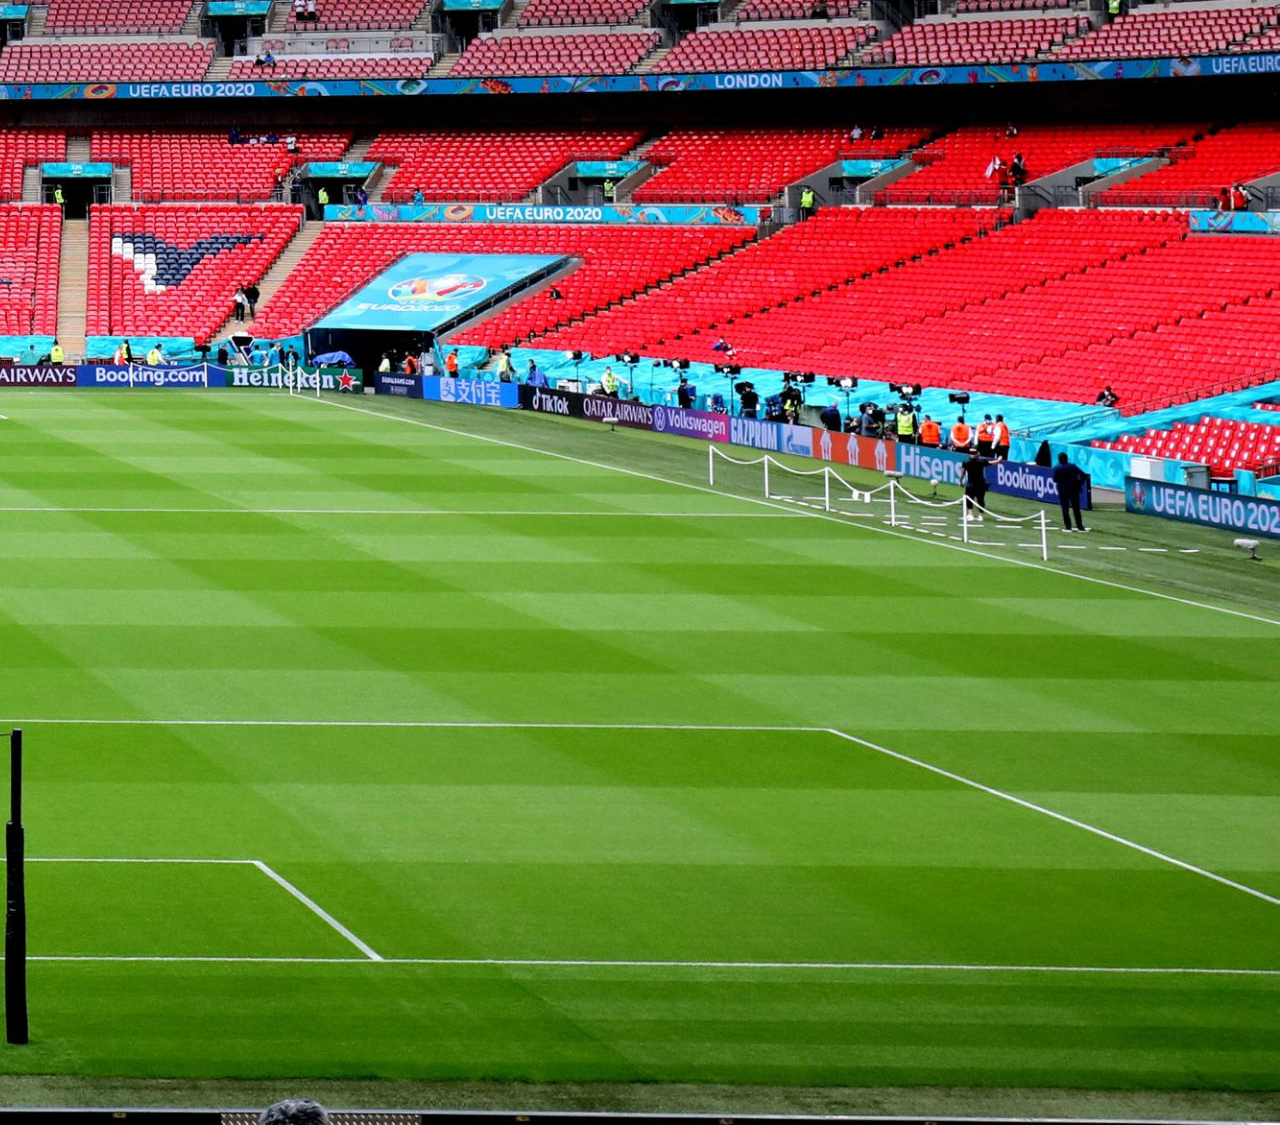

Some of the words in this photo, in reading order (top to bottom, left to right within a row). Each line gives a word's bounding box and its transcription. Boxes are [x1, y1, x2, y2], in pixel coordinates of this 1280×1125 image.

[1212, 57, 1247, 74] UEFA
[129, 84, 170, 97] UEFA
[171, 83, 214, 97] EURO
[215, 83, 255, 96] 2020
[715, 73, 783, 89] LONDON
[486, 207, 523, 220] UEFA
[524, 207, 563, 220] EURO
[565, 208, 602, 221] 2020
[96, 366, 206, 386] Booking.com
[232, 367, 335, 389] Heineken
[457, 380, 500, 407] 支付宝
[541, 392, 569, 415] TikTok
[583, 398, 613, 419] QATAR
[614, 402, 653, 425] AIRWAYS
[668, 409, 726, 438] Volkswagen
[730, 418, 778, 451] GAZPROM
[901, 446, 965, 486] Hisens
[1152, 486, 1195, 519] UEFA
[1199, 495, 1245, 527] EURO
